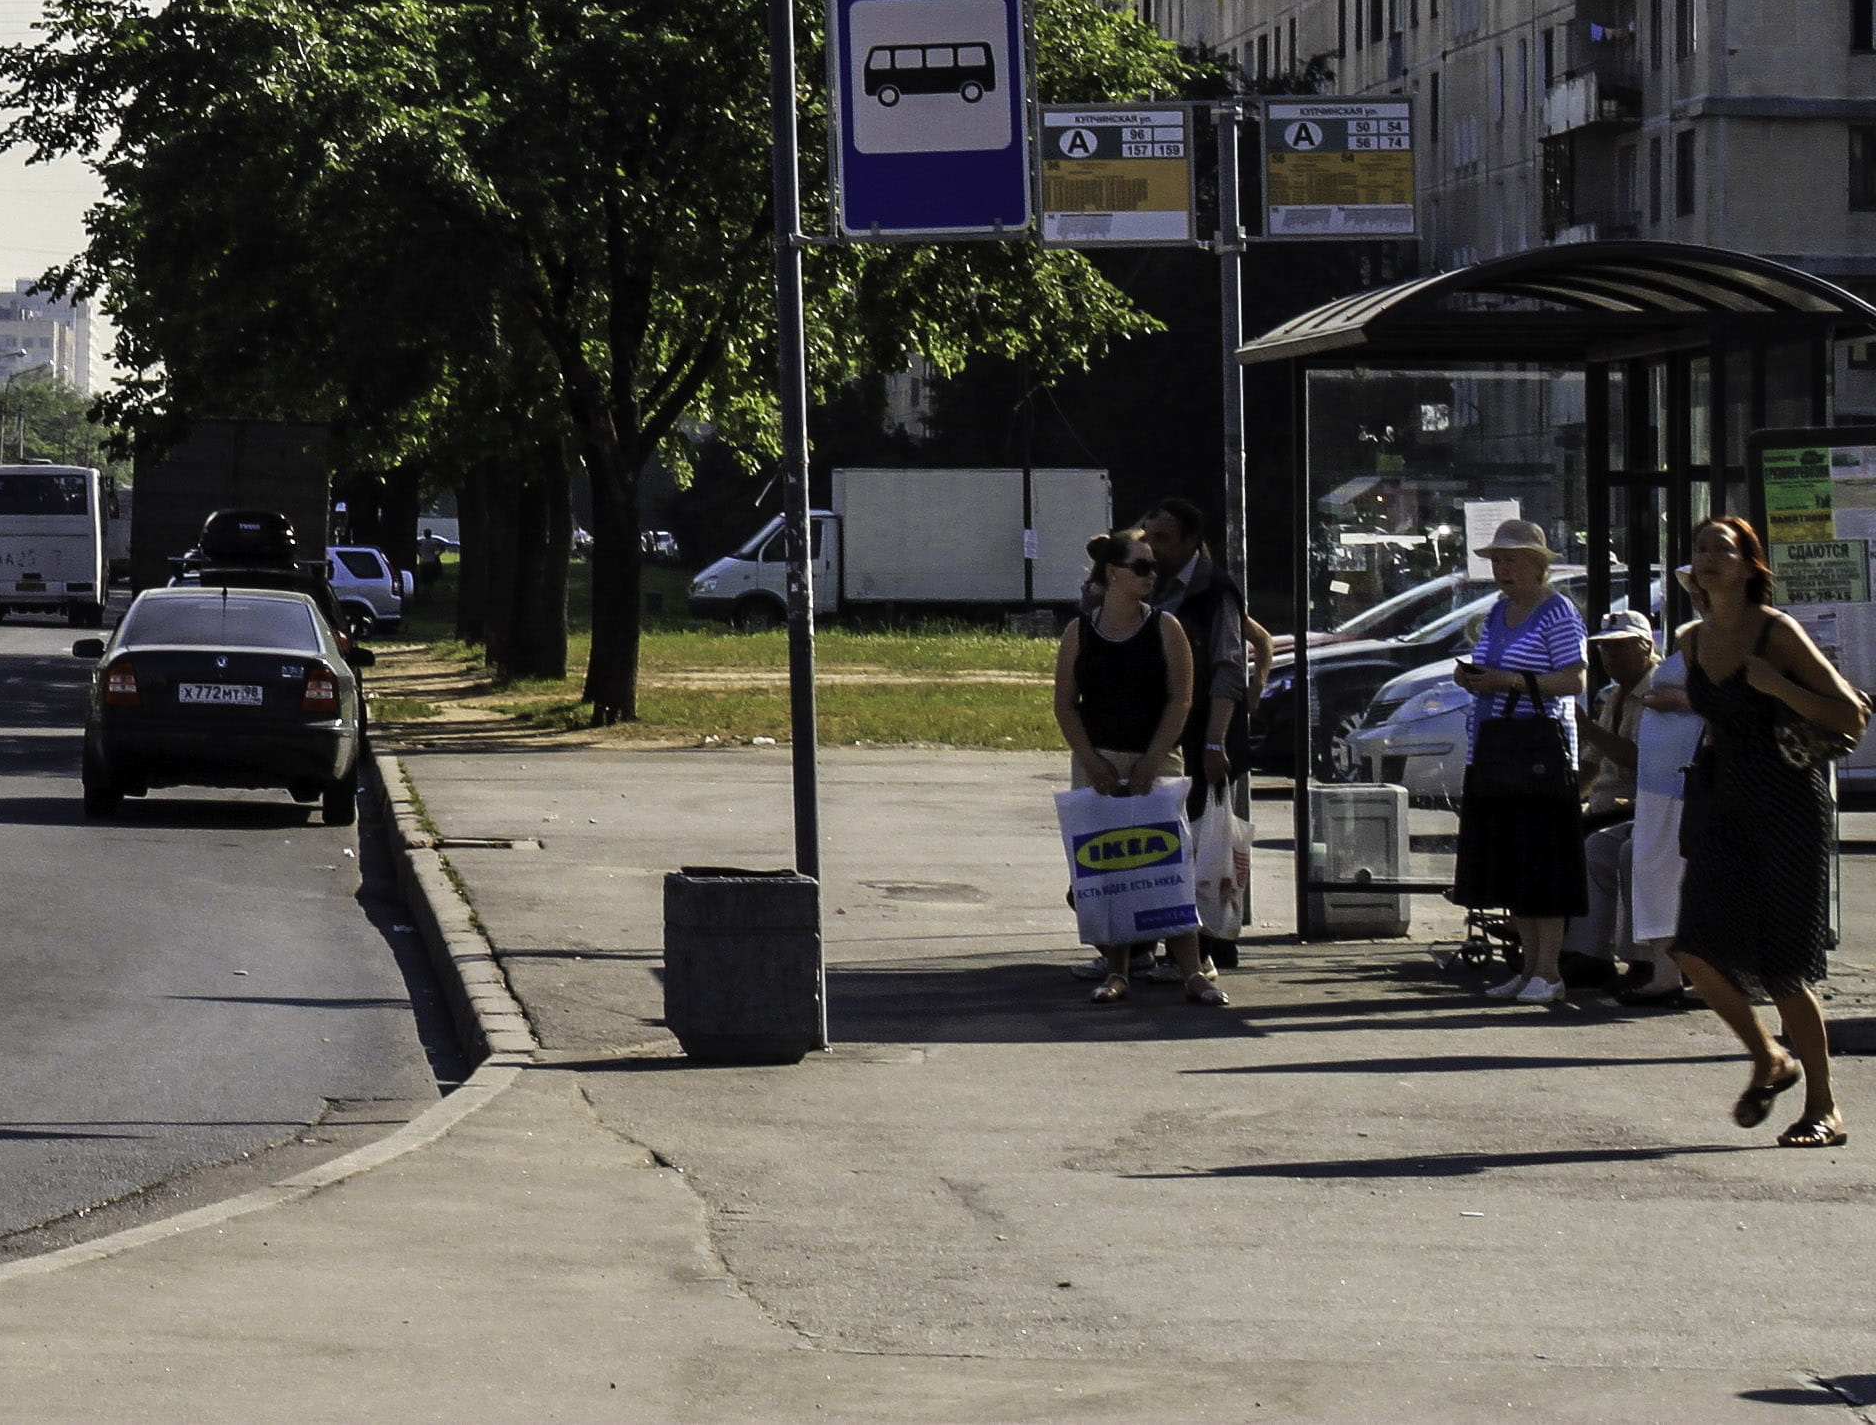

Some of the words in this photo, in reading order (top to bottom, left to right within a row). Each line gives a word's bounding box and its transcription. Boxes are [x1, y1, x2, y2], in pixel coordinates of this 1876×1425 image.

[1356, 122, 1370, 132] 50
[1388, 121, 1402, 132] 54
[1129, 129, 1145, 140] 96
[1356, 138, 1371, 149] 56
[1388, 138, 1402, 147] 74
[1127, 145, 1148, 156] 157
[1159, 145, 1180, 156] 159
[1788, 543, 1849, 561] СДАЮТСЯ
[246, 687, 258, 697] 98
[1089, 836, 1169, 862] IKEA
[1077, 888, 1101, 899] ЕСТЬ
[1130, 879, 1153, 891] ЕСТЬ
